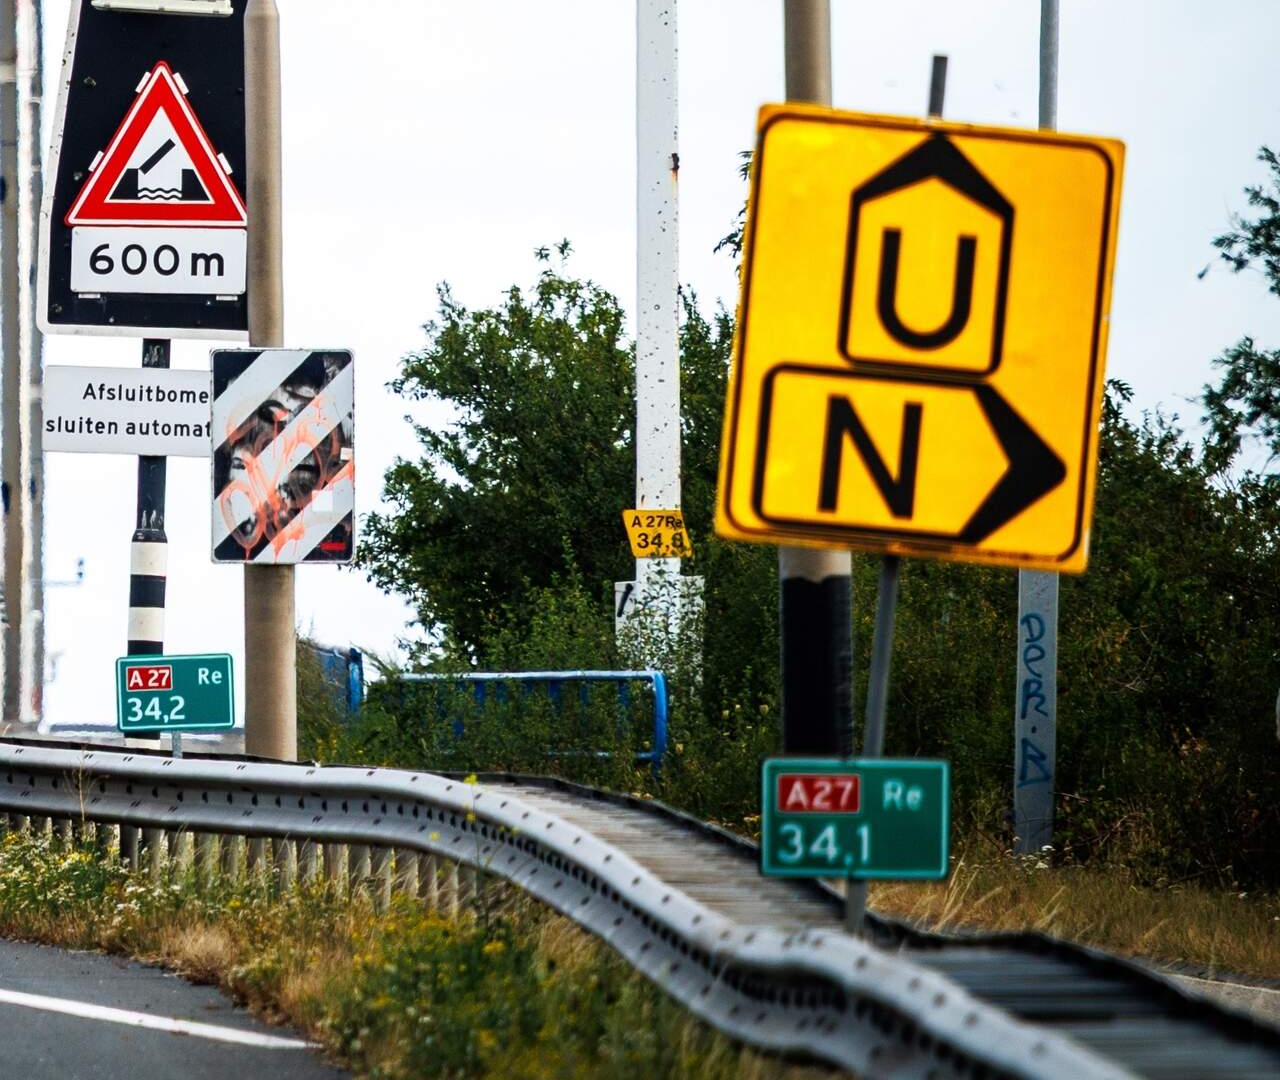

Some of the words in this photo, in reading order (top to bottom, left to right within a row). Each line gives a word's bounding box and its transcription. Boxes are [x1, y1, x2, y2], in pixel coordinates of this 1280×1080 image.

[88, 242, 181, 277] 600
[190, 251, 225, 277] m
[876, 226, 978, 351] U
[45, 416, 119, 436] sluiten
[816, 394, 924, 520] N
[197, 666, 223, 685] Re
[126, 695, 186, 724] 34,2
[882, 778, 923, 812] Re
